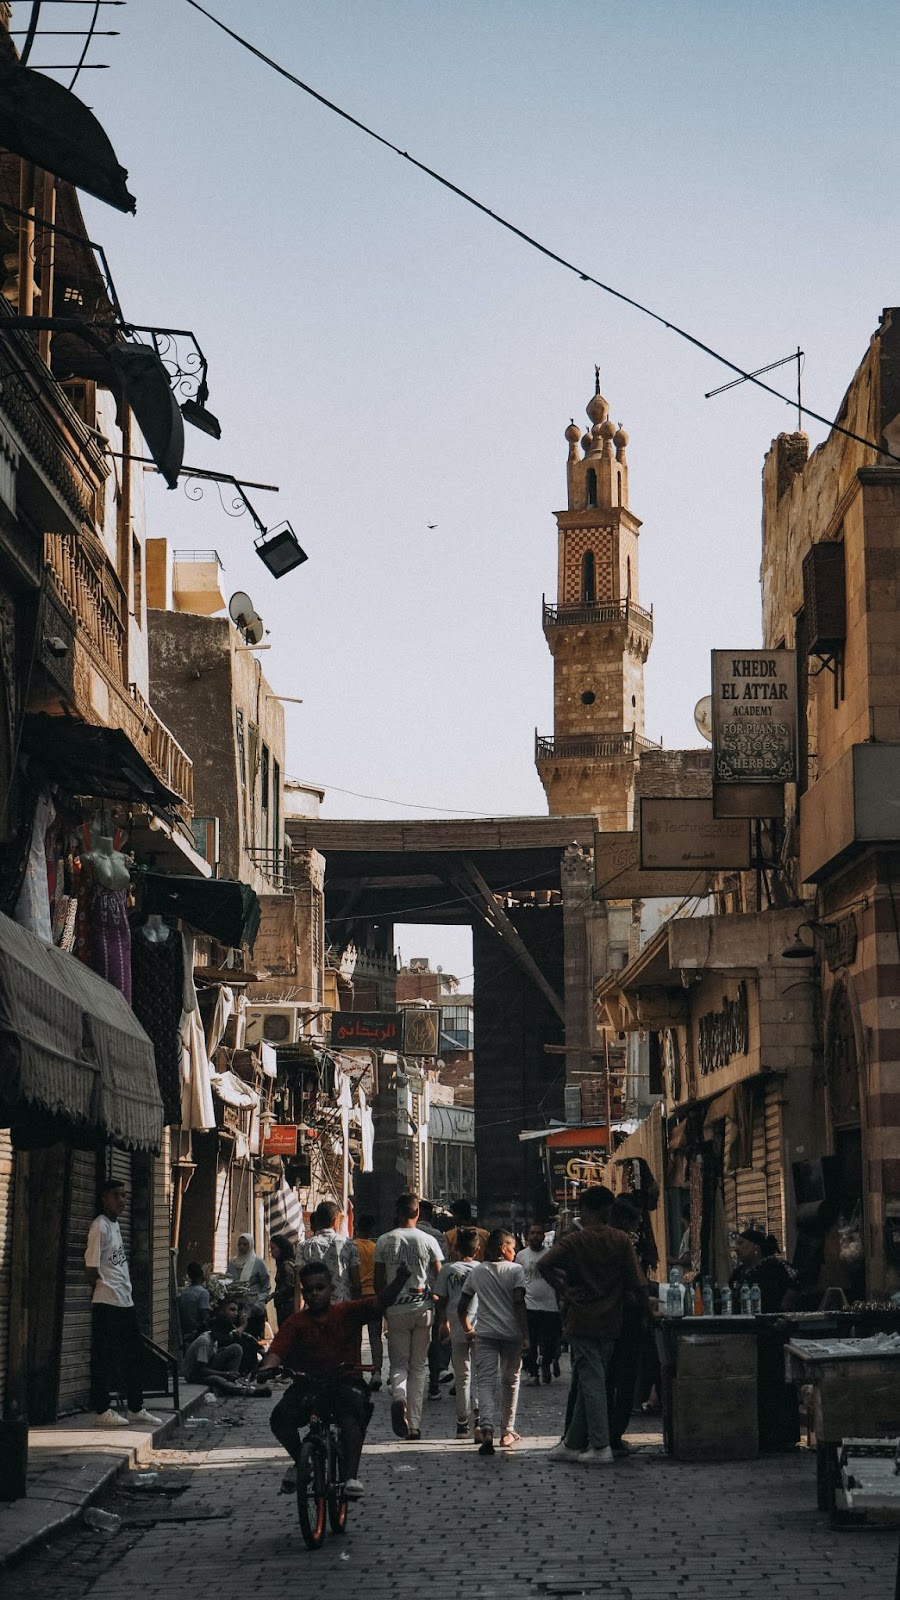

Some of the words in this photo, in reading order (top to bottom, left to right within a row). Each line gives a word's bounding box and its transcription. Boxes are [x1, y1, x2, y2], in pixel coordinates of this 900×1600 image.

[732, 659, 777, 678] KHEDR
[721, 683, 739, 700] EL
[742, 683, 788, 700] ATTAR
[732, 706, 773, 716] ACADEMY
[723, 724, 743, 735] FOR
[733, 758, 777, 769] HERBES
